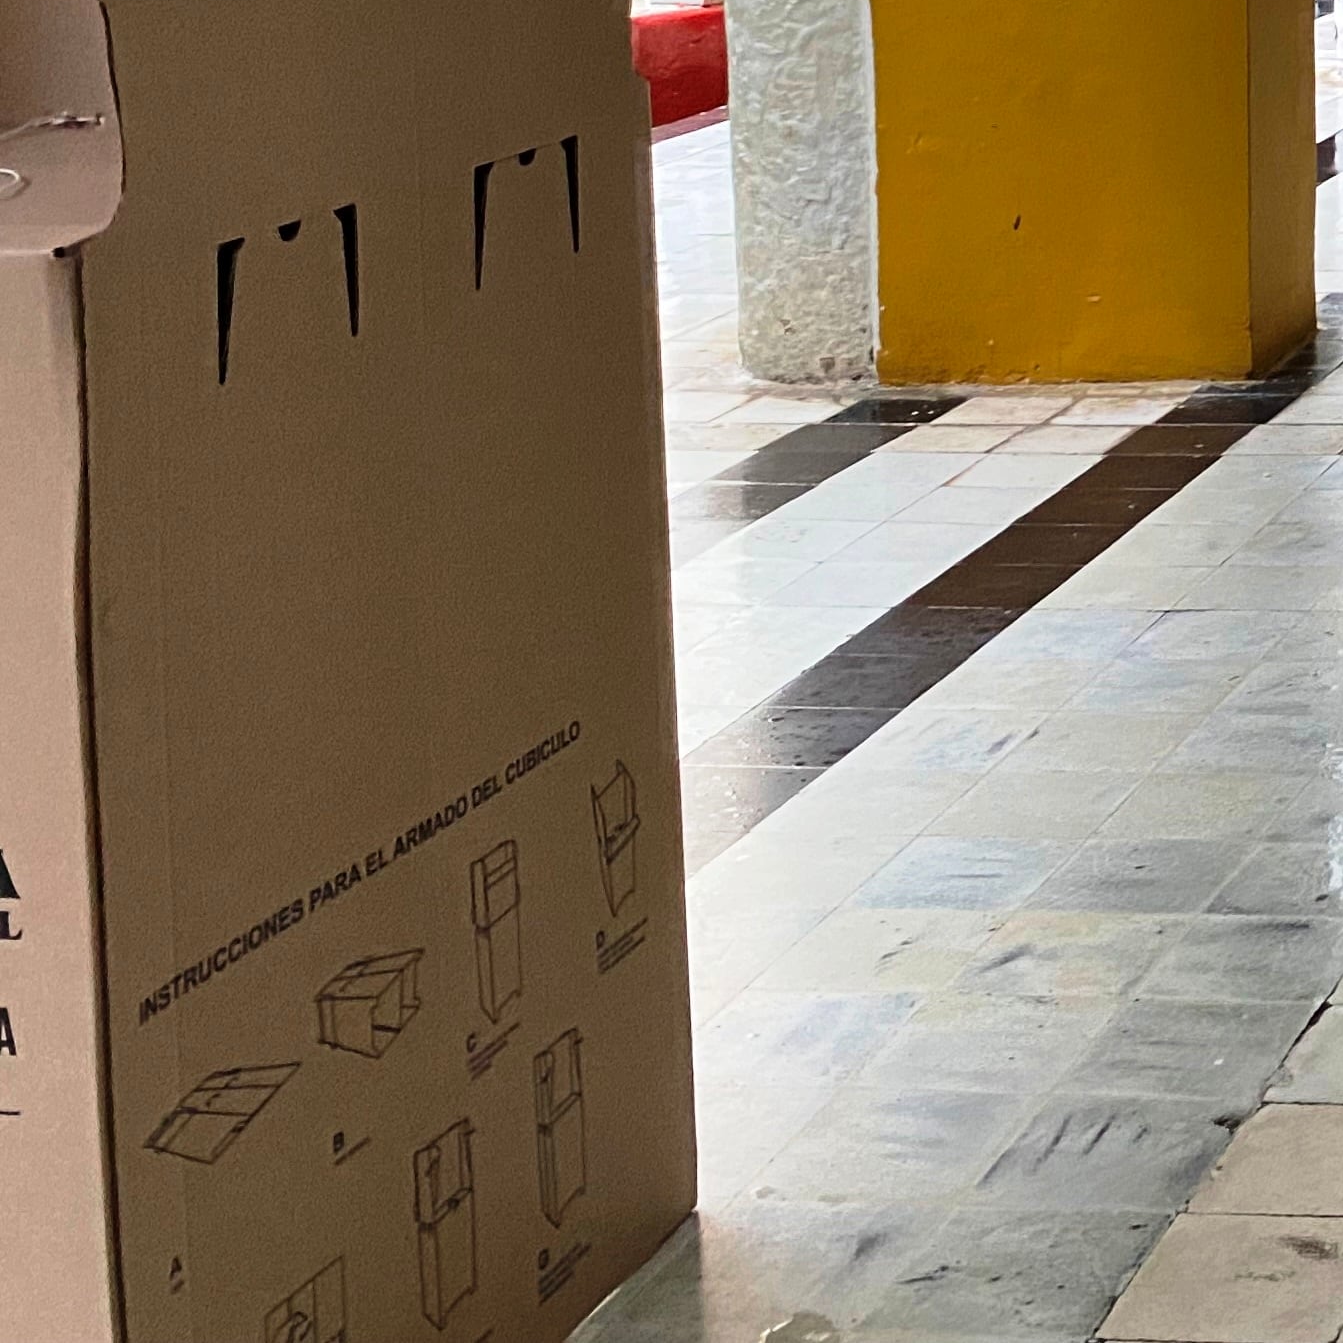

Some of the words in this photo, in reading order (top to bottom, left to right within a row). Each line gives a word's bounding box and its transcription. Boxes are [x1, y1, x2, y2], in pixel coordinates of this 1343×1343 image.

[138, 897, 305, 1027] INSTRUCCIONES
[308, 863, 362, 913] PARA
[365, 848, 388, 877] EL
[393, 795, 468, 860] ARMADO
[471, 775, 503, 809] DEL
[505, 720, 580, 785] CUBICULO
